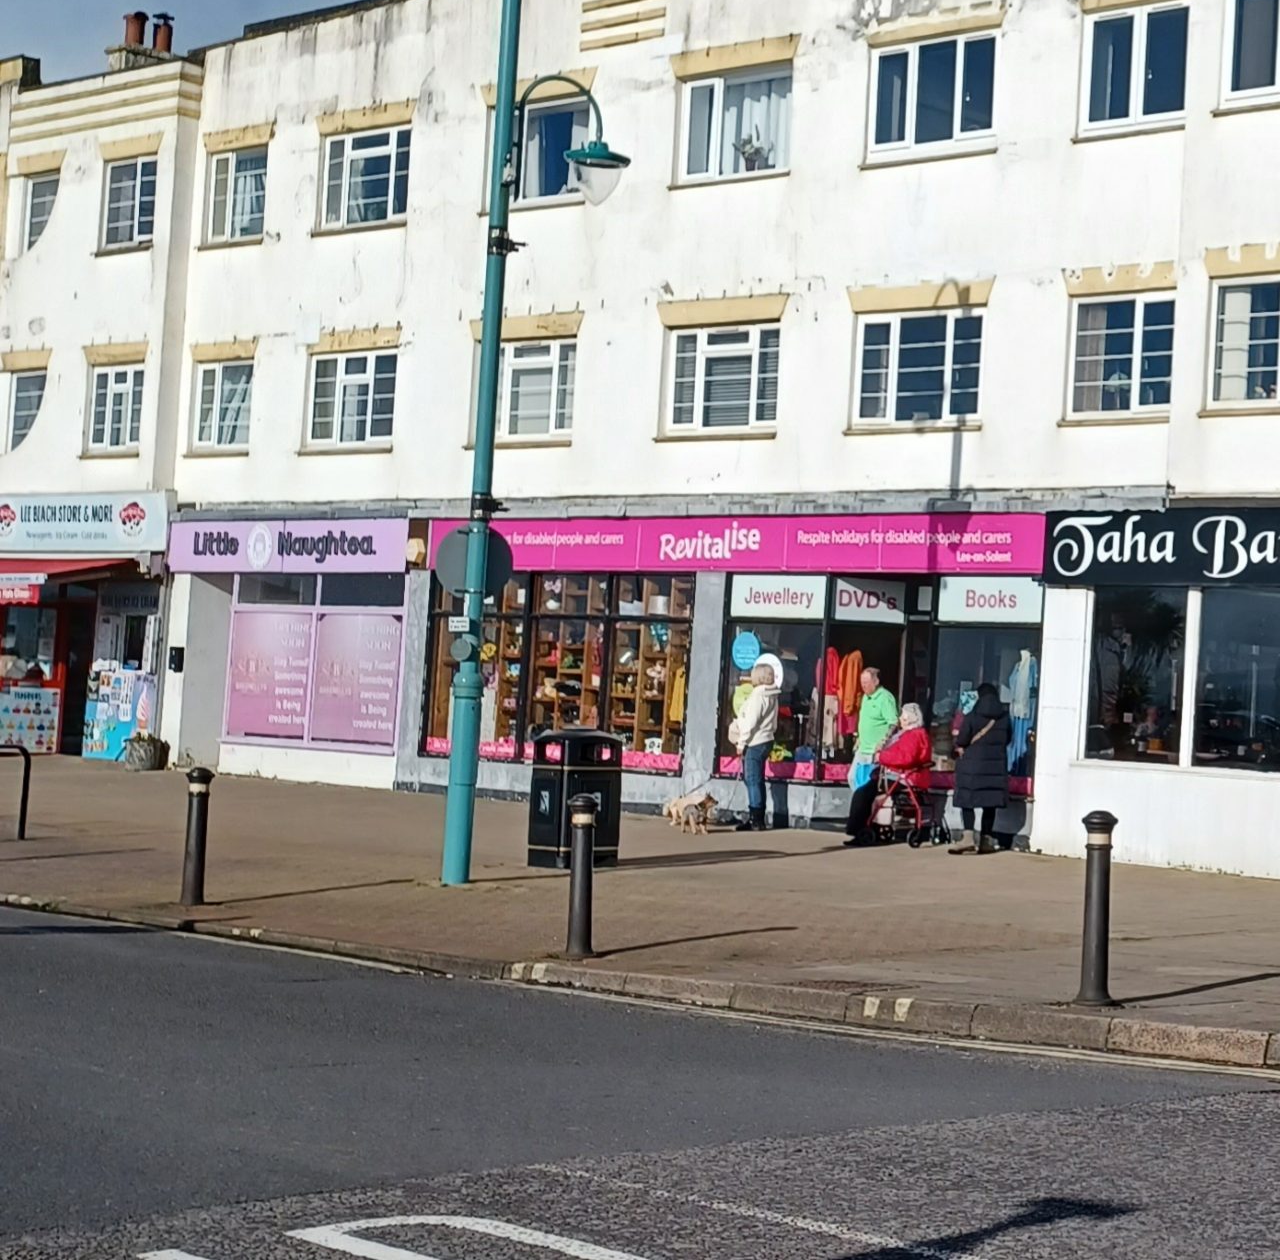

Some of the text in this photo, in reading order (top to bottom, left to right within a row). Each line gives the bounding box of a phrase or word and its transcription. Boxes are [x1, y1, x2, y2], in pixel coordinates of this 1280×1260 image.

[33, 504, 57, 523] BEACH
[58, 504, 81, 523] STORE
[84, 505, 89, 523] &
[91, 504, 113, 522] MORE
[193, 531, 239, 556] Little
[512, 532, 523, 545] for
[524, 532, 555, 545] disabled
[556, 532, 584, 549] people
[584, 532, 600, 545] and
[601, 534, 624, 545] carers
[659, 520, 761, 561] Revitalise
[798, 529, 1012, 547] Respite holidays for disabled people and carers
[1052, 515, 1176, 577] Taha
[956, 550, 1012, 563] Lee-on-Solent
[744, 587, 814, 608] Jewellery
[838, 589, 898, 610] DVD's
[965, 589, 1017, 609] Books
